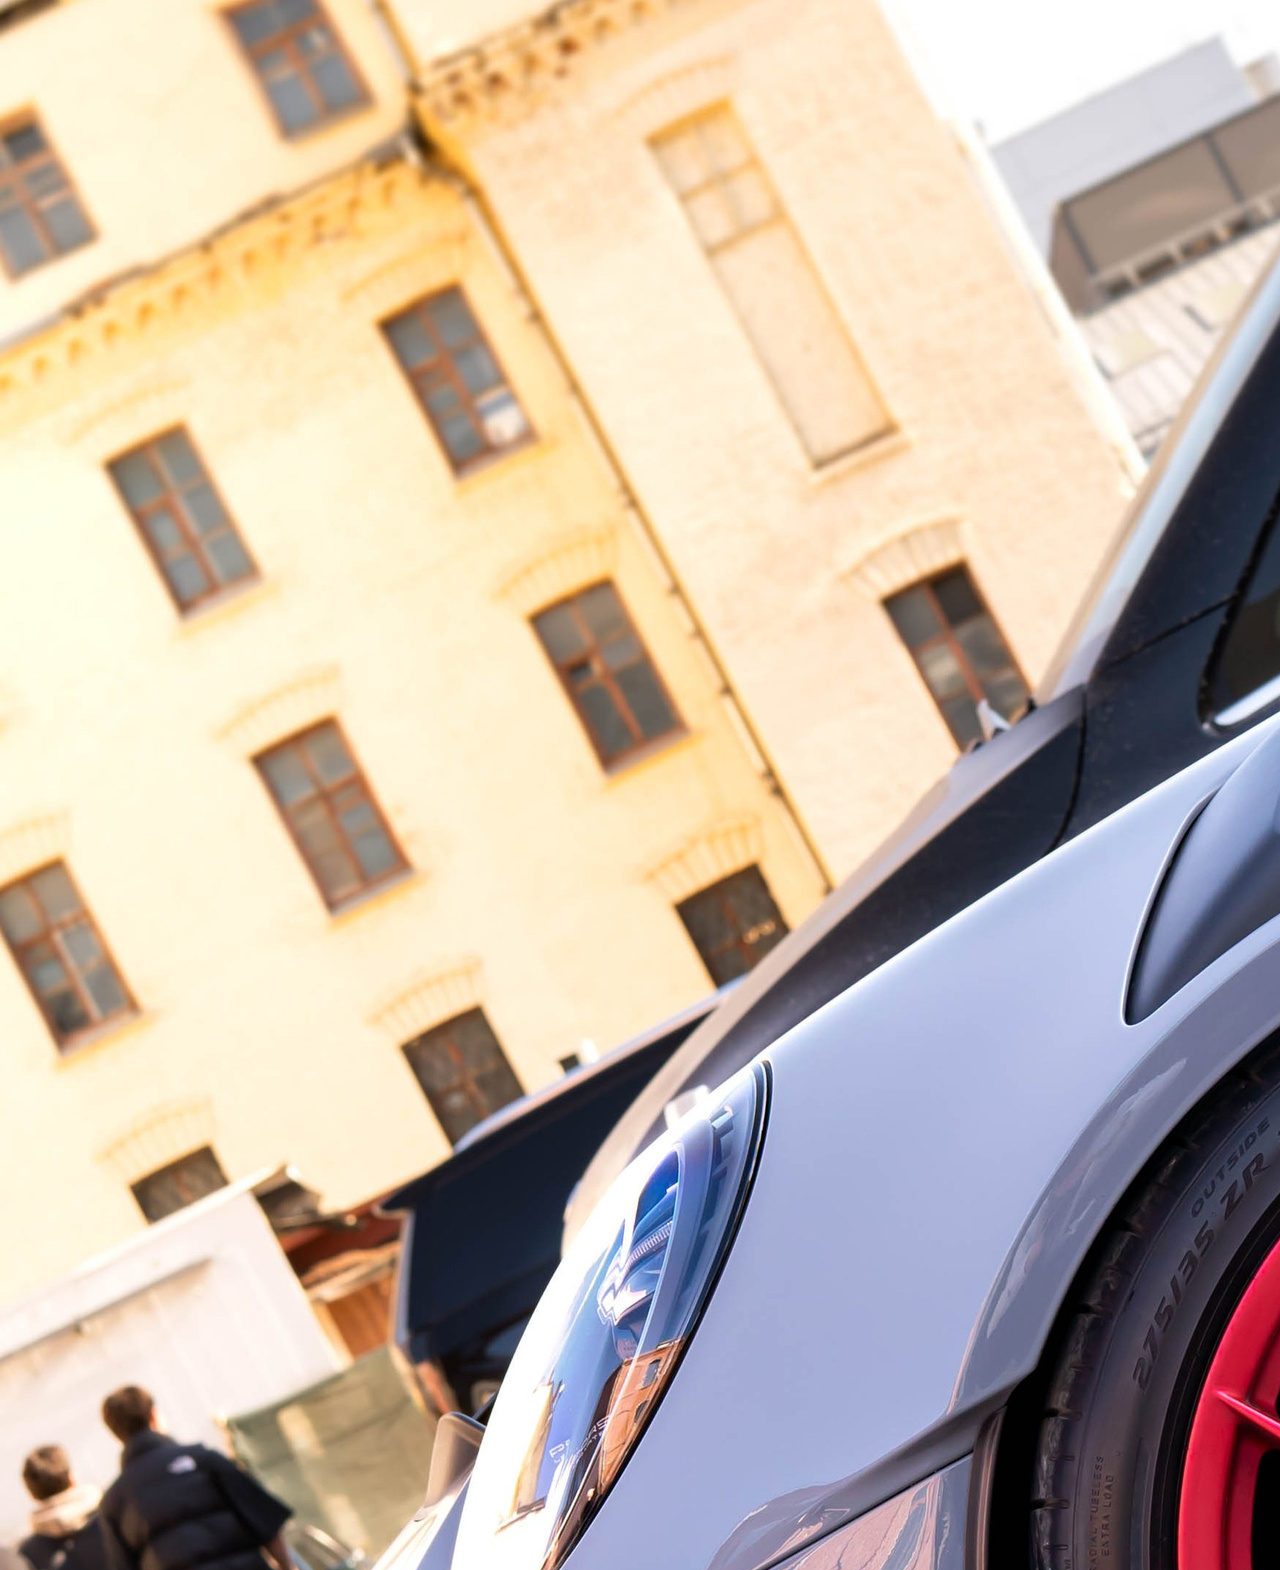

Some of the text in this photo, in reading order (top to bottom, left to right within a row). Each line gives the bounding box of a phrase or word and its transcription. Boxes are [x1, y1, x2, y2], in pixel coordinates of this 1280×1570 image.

[1190, 1116, 1271, 1218] OUTSIDE
[1132, 1219, 1216, 1391] 275/35
[1219, 1151, 1272, 1222] ZR
[1089, 1455, 1104, 1522] TUBELESS
